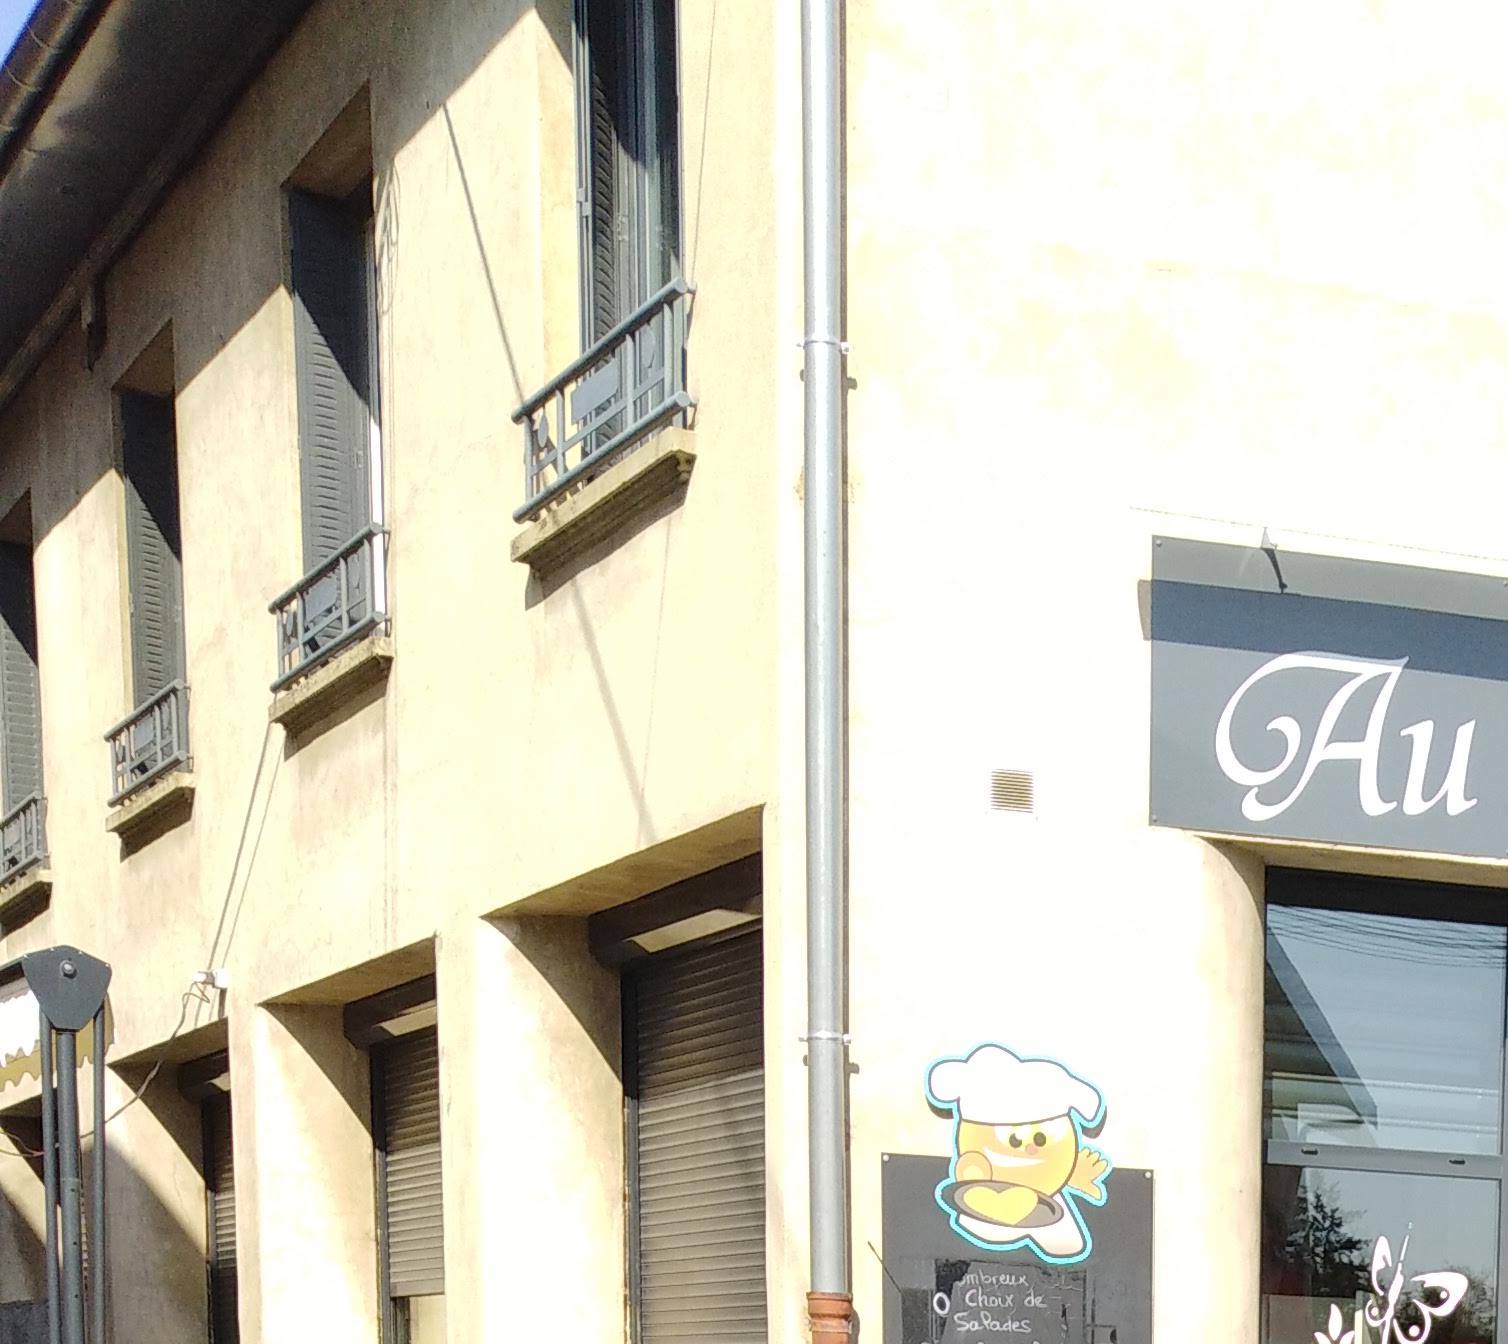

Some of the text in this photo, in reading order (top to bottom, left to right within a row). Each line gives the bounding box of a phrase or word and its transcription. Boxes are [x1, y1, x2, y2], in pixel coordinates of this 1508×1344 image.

[1215, 650, 1478, 822] Au
[1023, 1288, 1047, 1309] de
[953, 1313, 1032, 1333] Salades
